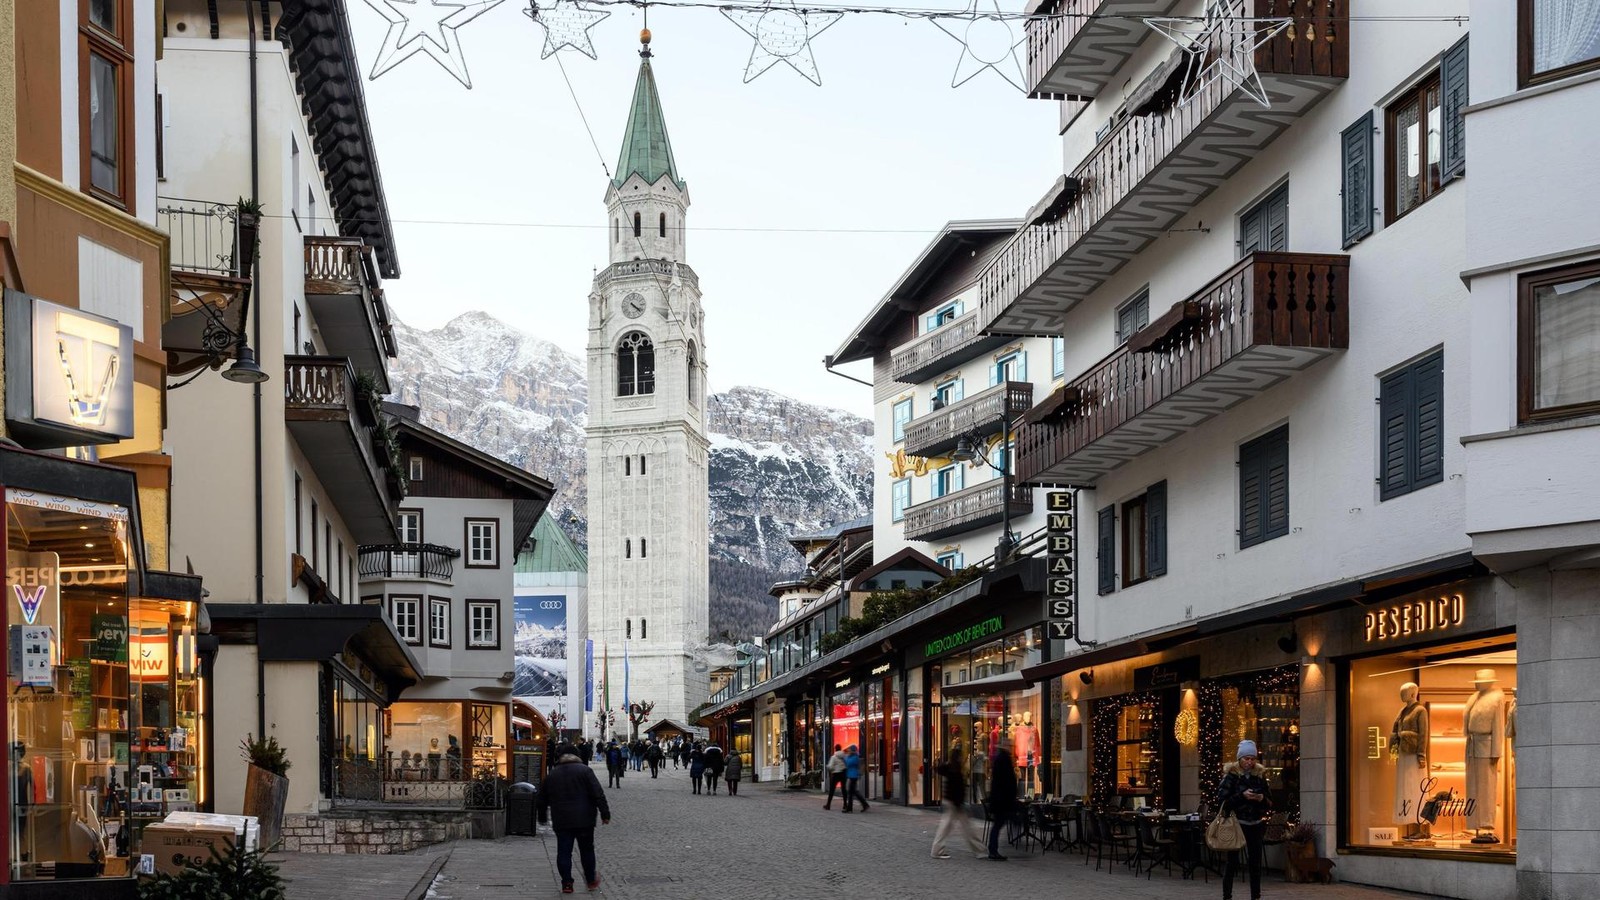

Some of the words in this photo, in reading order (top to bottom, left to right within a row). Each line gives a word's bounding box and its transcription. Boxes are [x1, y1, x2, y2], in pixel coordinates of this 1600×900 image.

[13, 496, 40, 506] WIND
[45, 502, 71, 511] WIND
[76, 507, 102, 516] WIND
[1052, 493, 1071, 636] EMBASSY
[925, 640, 943, 657] UNITED
[943, 630, 964, 651] COLORS
[963, 628, 972, 643] OF
[971, 616, 1003, 639] BENETTON
[1365, 594, 1464, 641] PESERICO
